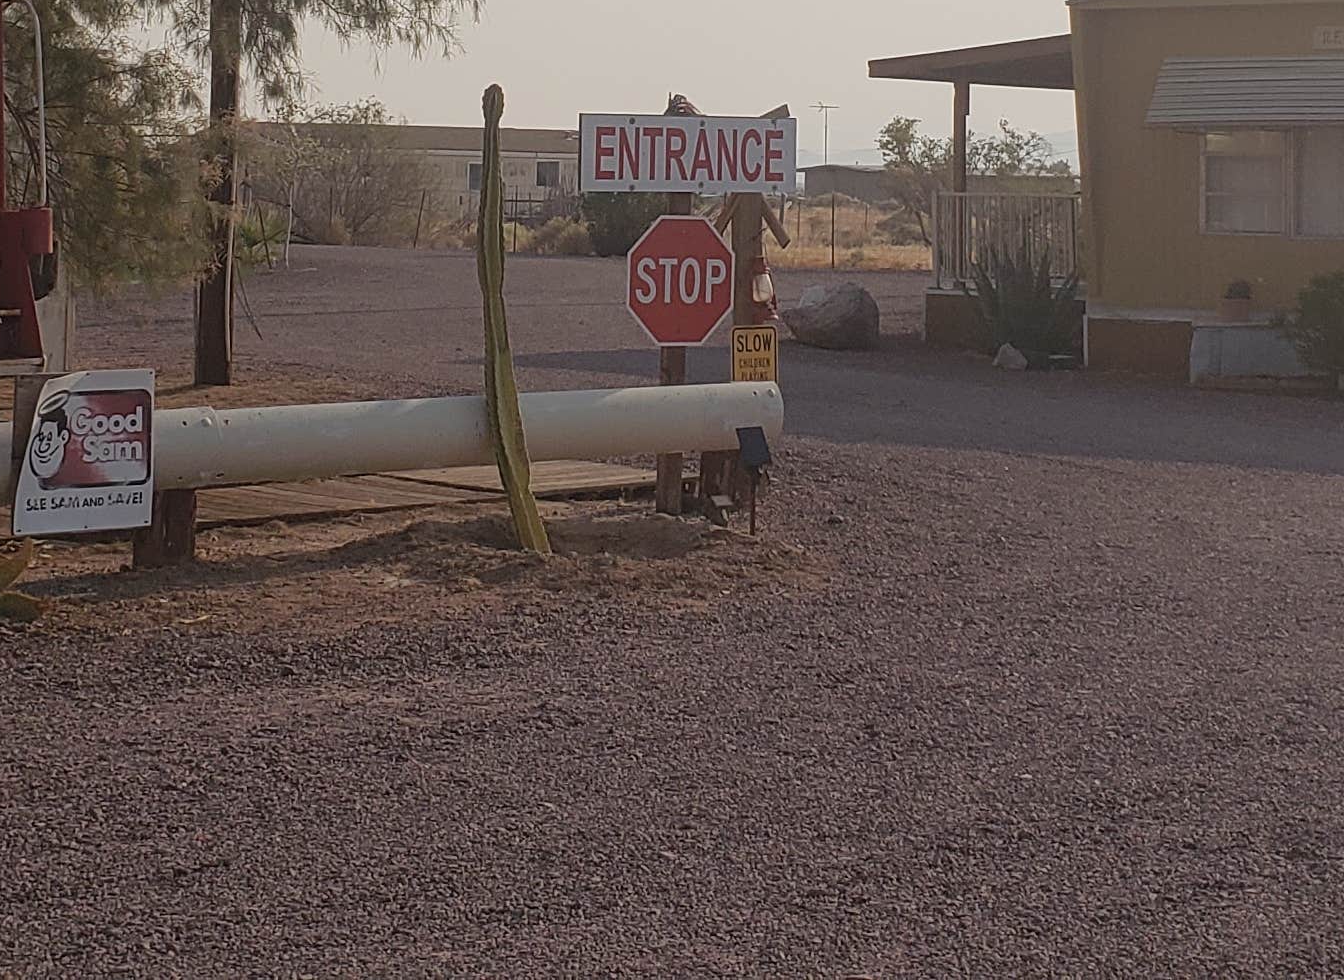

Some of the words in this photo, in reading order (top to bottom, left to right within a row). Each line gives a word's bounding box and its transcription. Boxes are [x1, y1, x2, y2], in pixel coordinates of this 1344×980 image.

[593, 126, 785, 183] ENTRANCE
[634, 257, 727, 305] STOP
[736, 333, 772, 353] SLOW
[739, 357, 771, 369] CHILDREN
[70, 406, 143, 435] Good
[82, 435, 143, 464] Sam
[82, 496, 105, 509] AND
